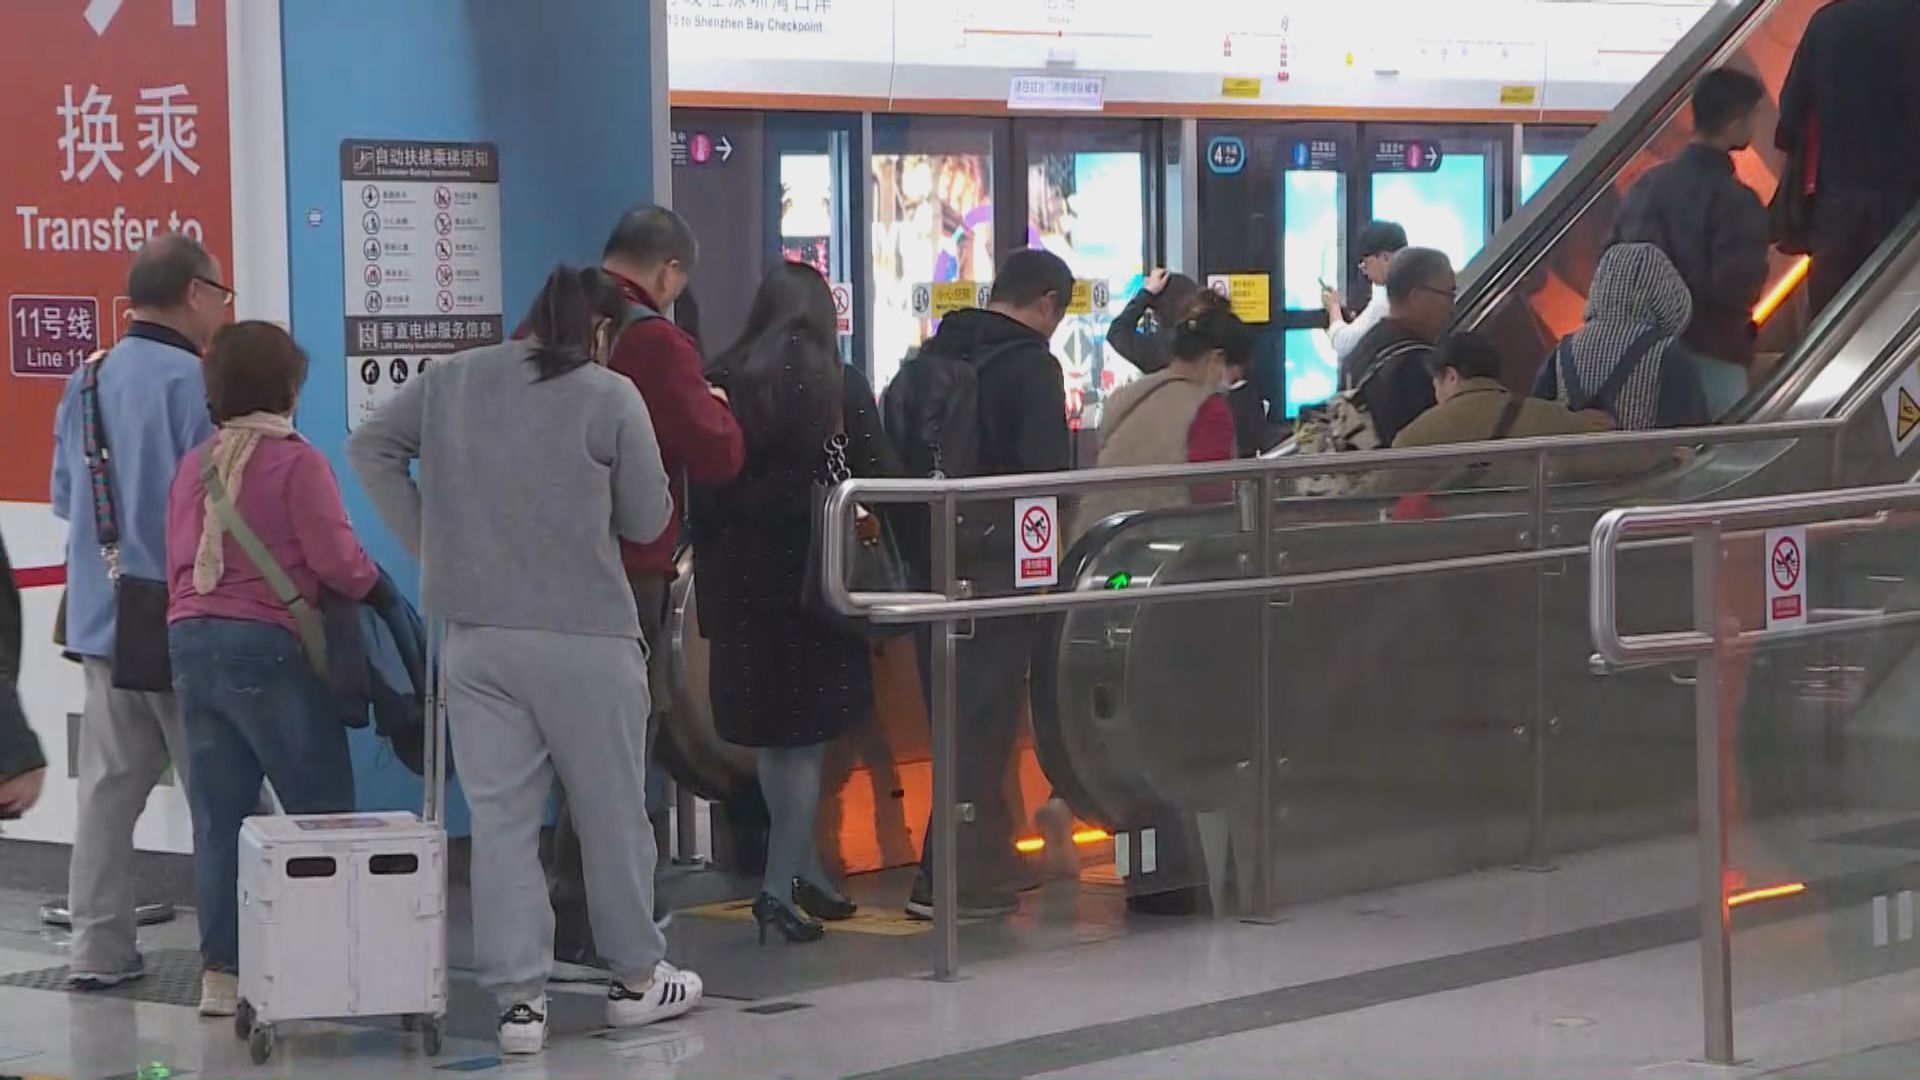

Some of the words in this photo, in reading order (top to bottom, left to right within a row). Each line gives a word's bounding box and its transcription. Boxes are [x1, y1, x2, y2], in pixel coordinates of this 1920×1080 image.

[681, 15, 692, 27] to
[694, 15, 744, 30] Shenzhen
[746, 18, 765, 32] Bay
[767, 18, 823, 33] Checkpoint
[56, 83, 201, 184] 换乘
[376, 146, 488, 167] 自动扶梯乘梯须知
[1214, 143, 1223, 164] 4
[410, 168, 430, 178] Safety
[16, 206, 159, 251] Transfer
[16, 306, 93, 341] 11号线
[380, 321, 492, 339] 垂直电梯服务信息
[394, 342, 414, 351] Safety
[27, 347, 62, 368] Line
[67, 348, 84, 368] 11
